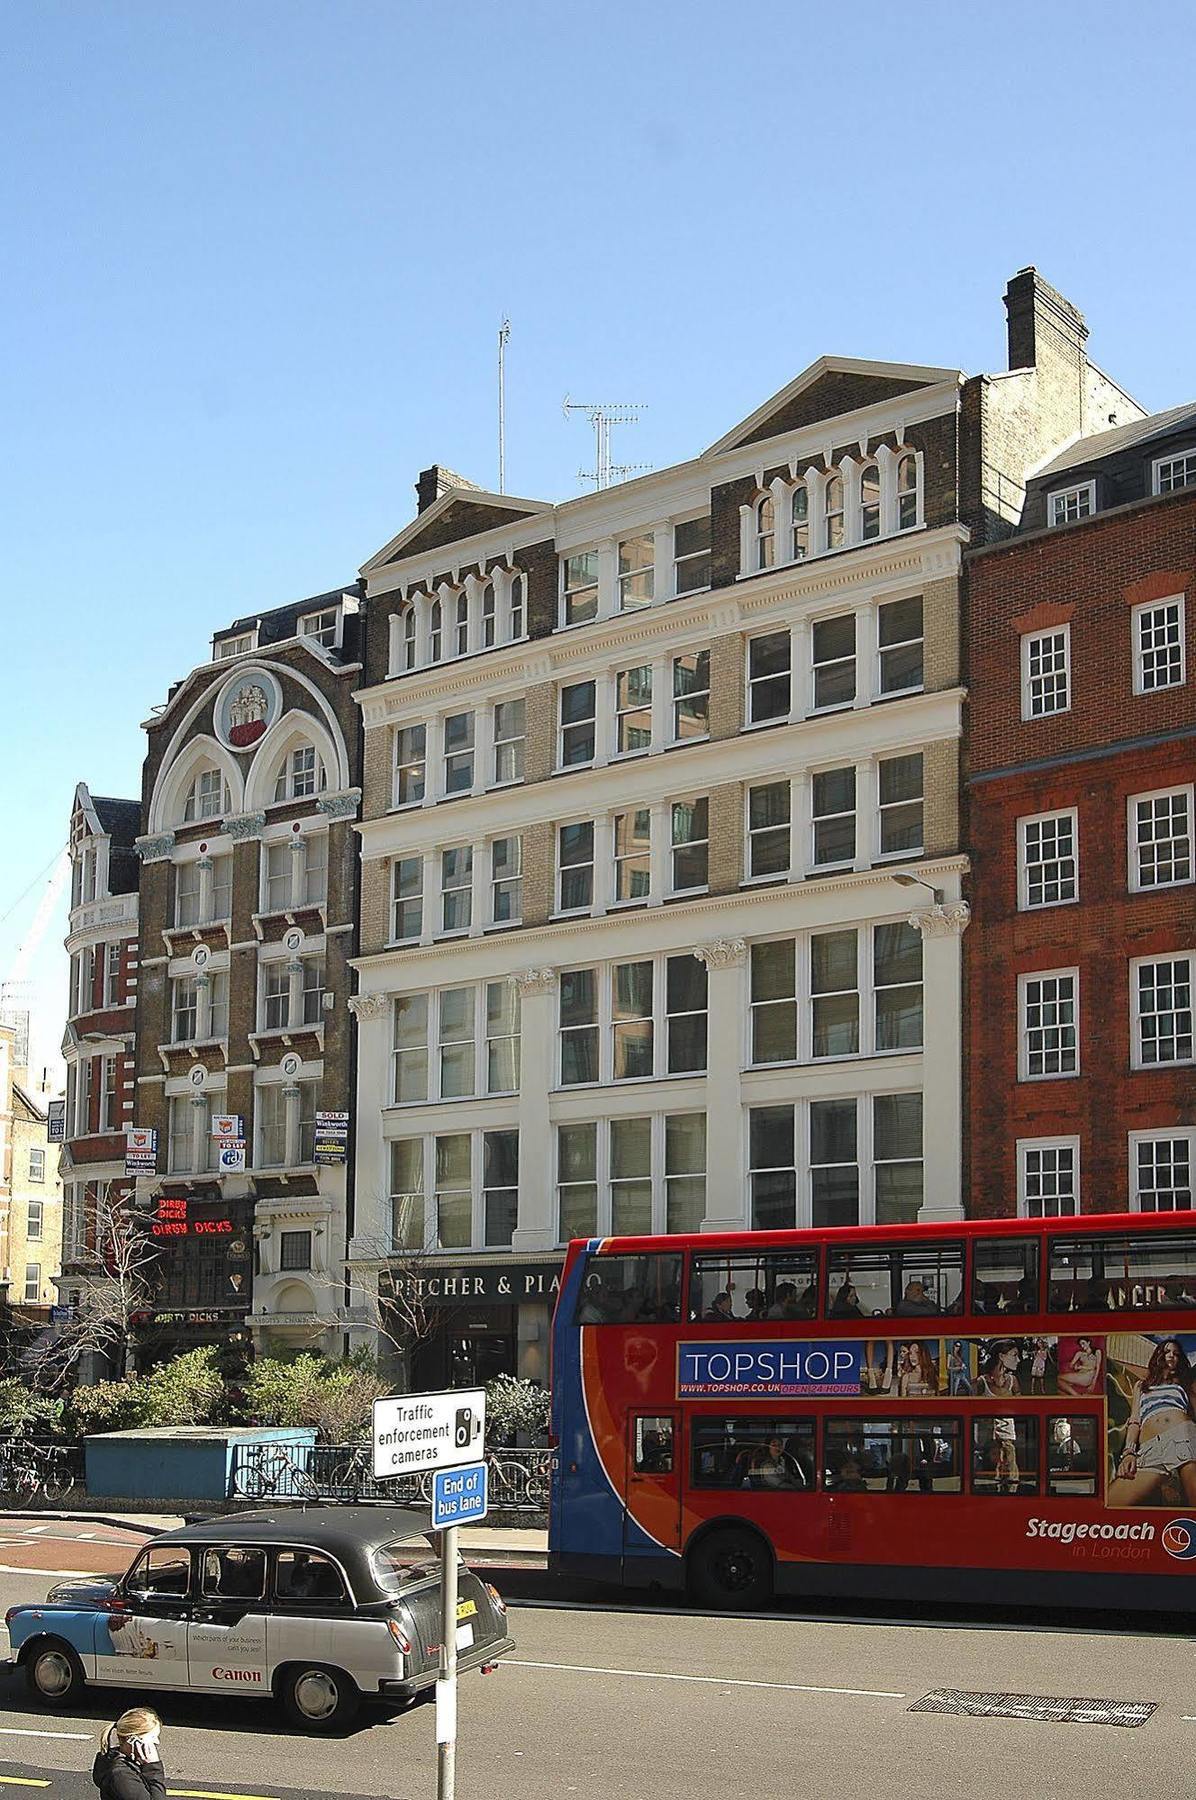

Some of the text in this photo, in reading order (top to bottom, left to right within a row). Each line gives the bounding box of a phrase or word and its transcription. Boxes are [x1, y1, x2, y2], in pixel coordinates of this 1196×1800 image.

[158, 1210, 187, 1219] DICKS
[194, 1220, 233, 1233] DICKS
[395, 1277, 486, 1296] PITCHER
[497, 1275, 512, 1295] &
[154, 1312, 219, 1323] DIRTY DICKS
[686, 1351, 854, 1381] TOPSHOP
[680, 1383, 781, 1393] WWW.TOPSHOP.CO.UK
[782, 1385, 808, 1394] OPEN
[825, 1383, 860, 1393] HOURS
[396, 1404, 434, 1422] Traffic
[378, 1422, 450, 1445] enforcement
[391, 1447, 438, 1465] cameras
[443, 1472, 479, 1495] End of
[438, 1495, 482, 1516] bus lane
[1026, 1518, 1155, 1544] Stagecoach
[1072, 1543, 1151, 1560] in London
[212, 1666, 262, 1682] Canon
